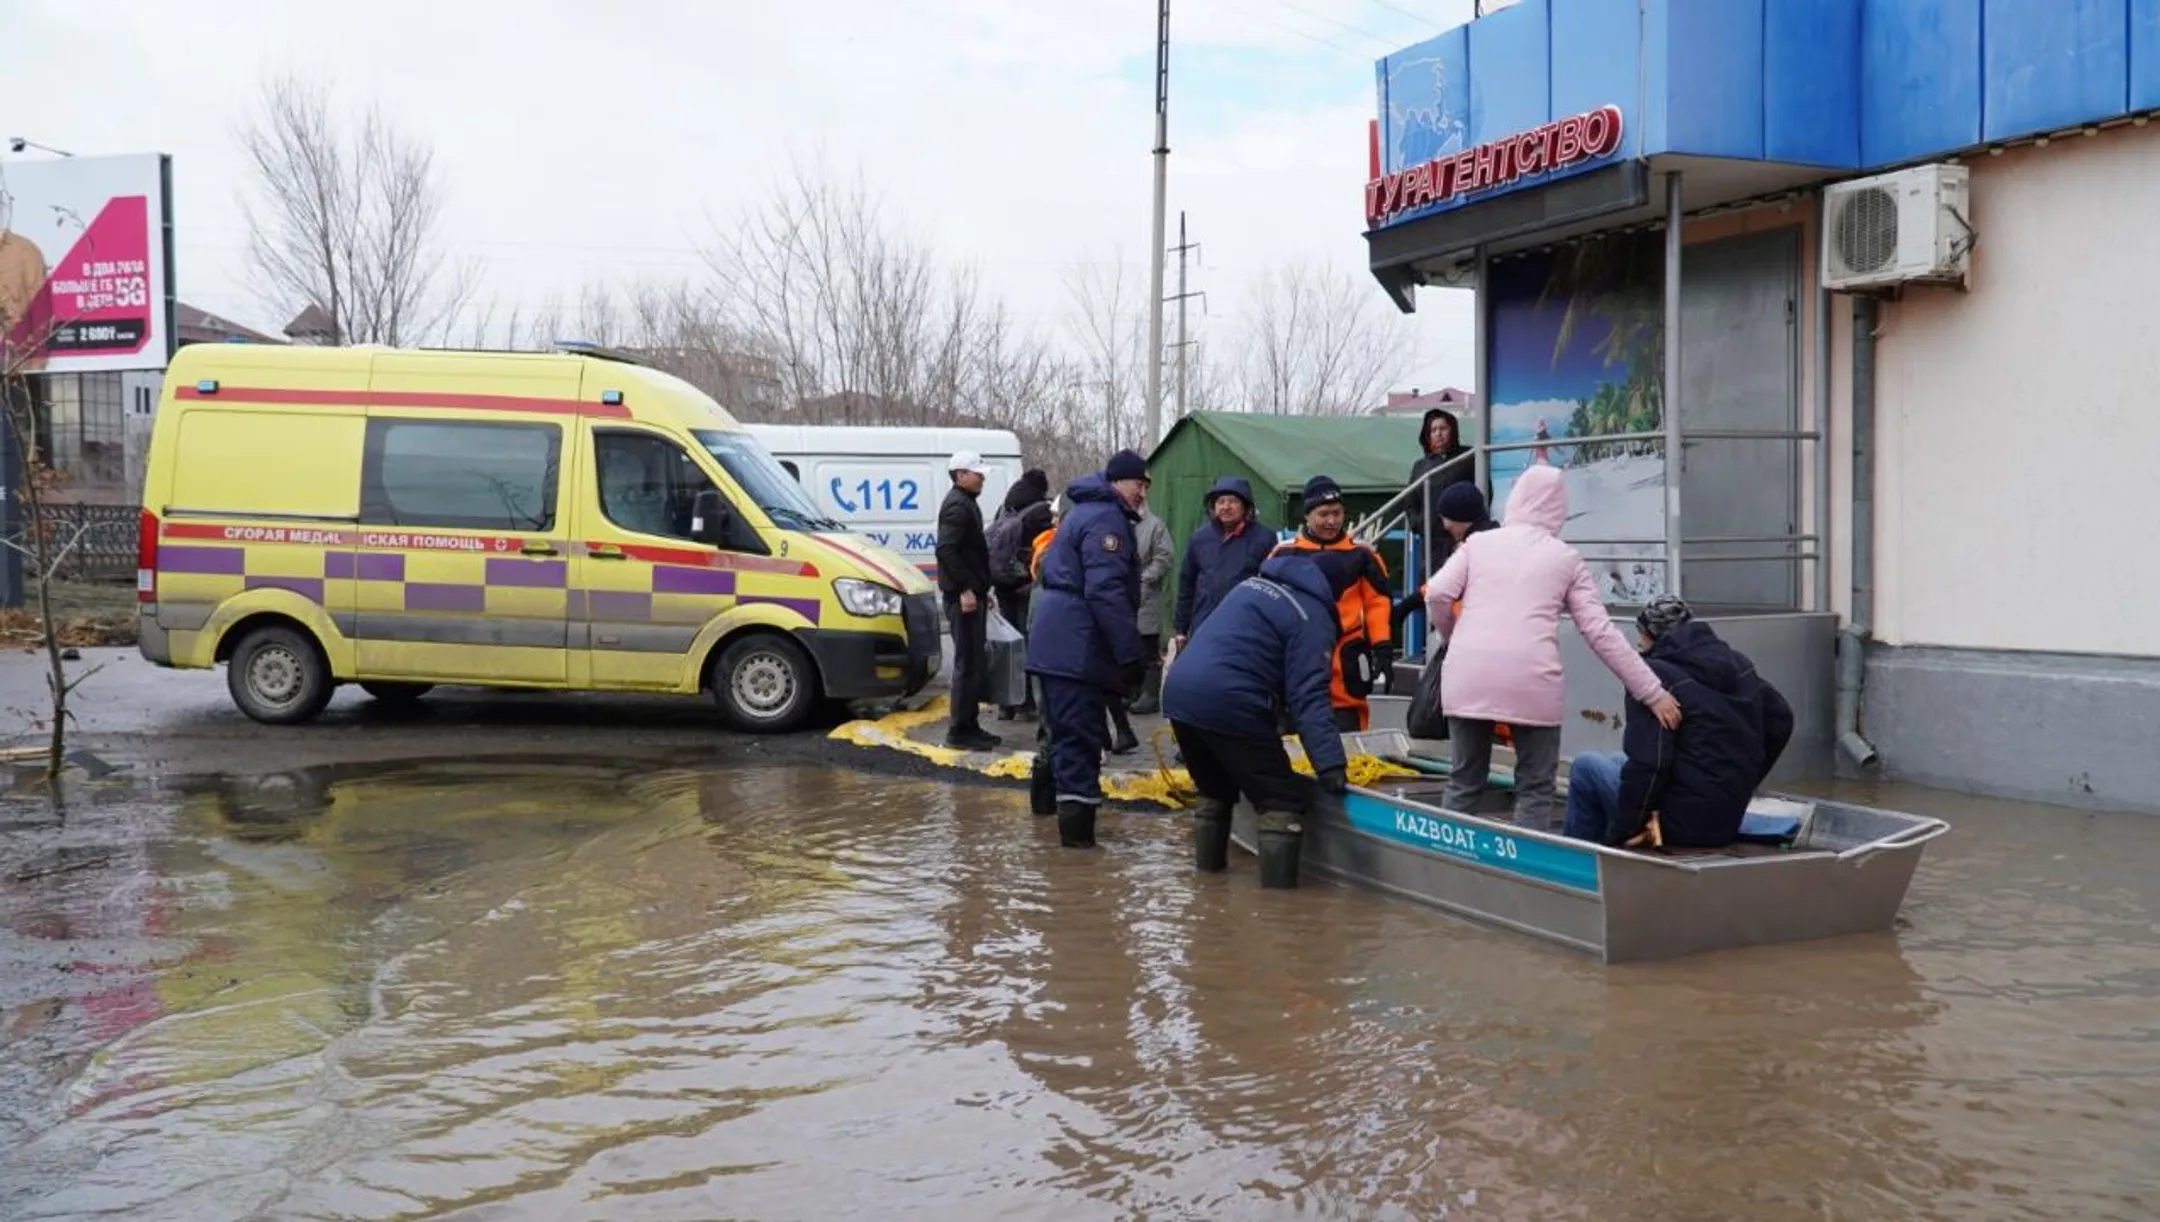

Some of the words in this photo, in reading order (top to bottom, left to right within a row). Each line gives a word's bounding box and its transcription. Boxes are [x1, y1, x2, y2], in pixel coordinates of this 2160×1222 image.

[1365, 104, 1623, 221] ТУРАГЕНТСТВО
[115, 276, 146, 306] 5G
[856, 479, 919, 510] 112
[412, 535, 485, 551] ПОМОЩЬ
[780, 540, 789, 557] 9
[1395, 811, 1476, 850] KAZBOAT
[1494, 835, 1518, 860] 30
